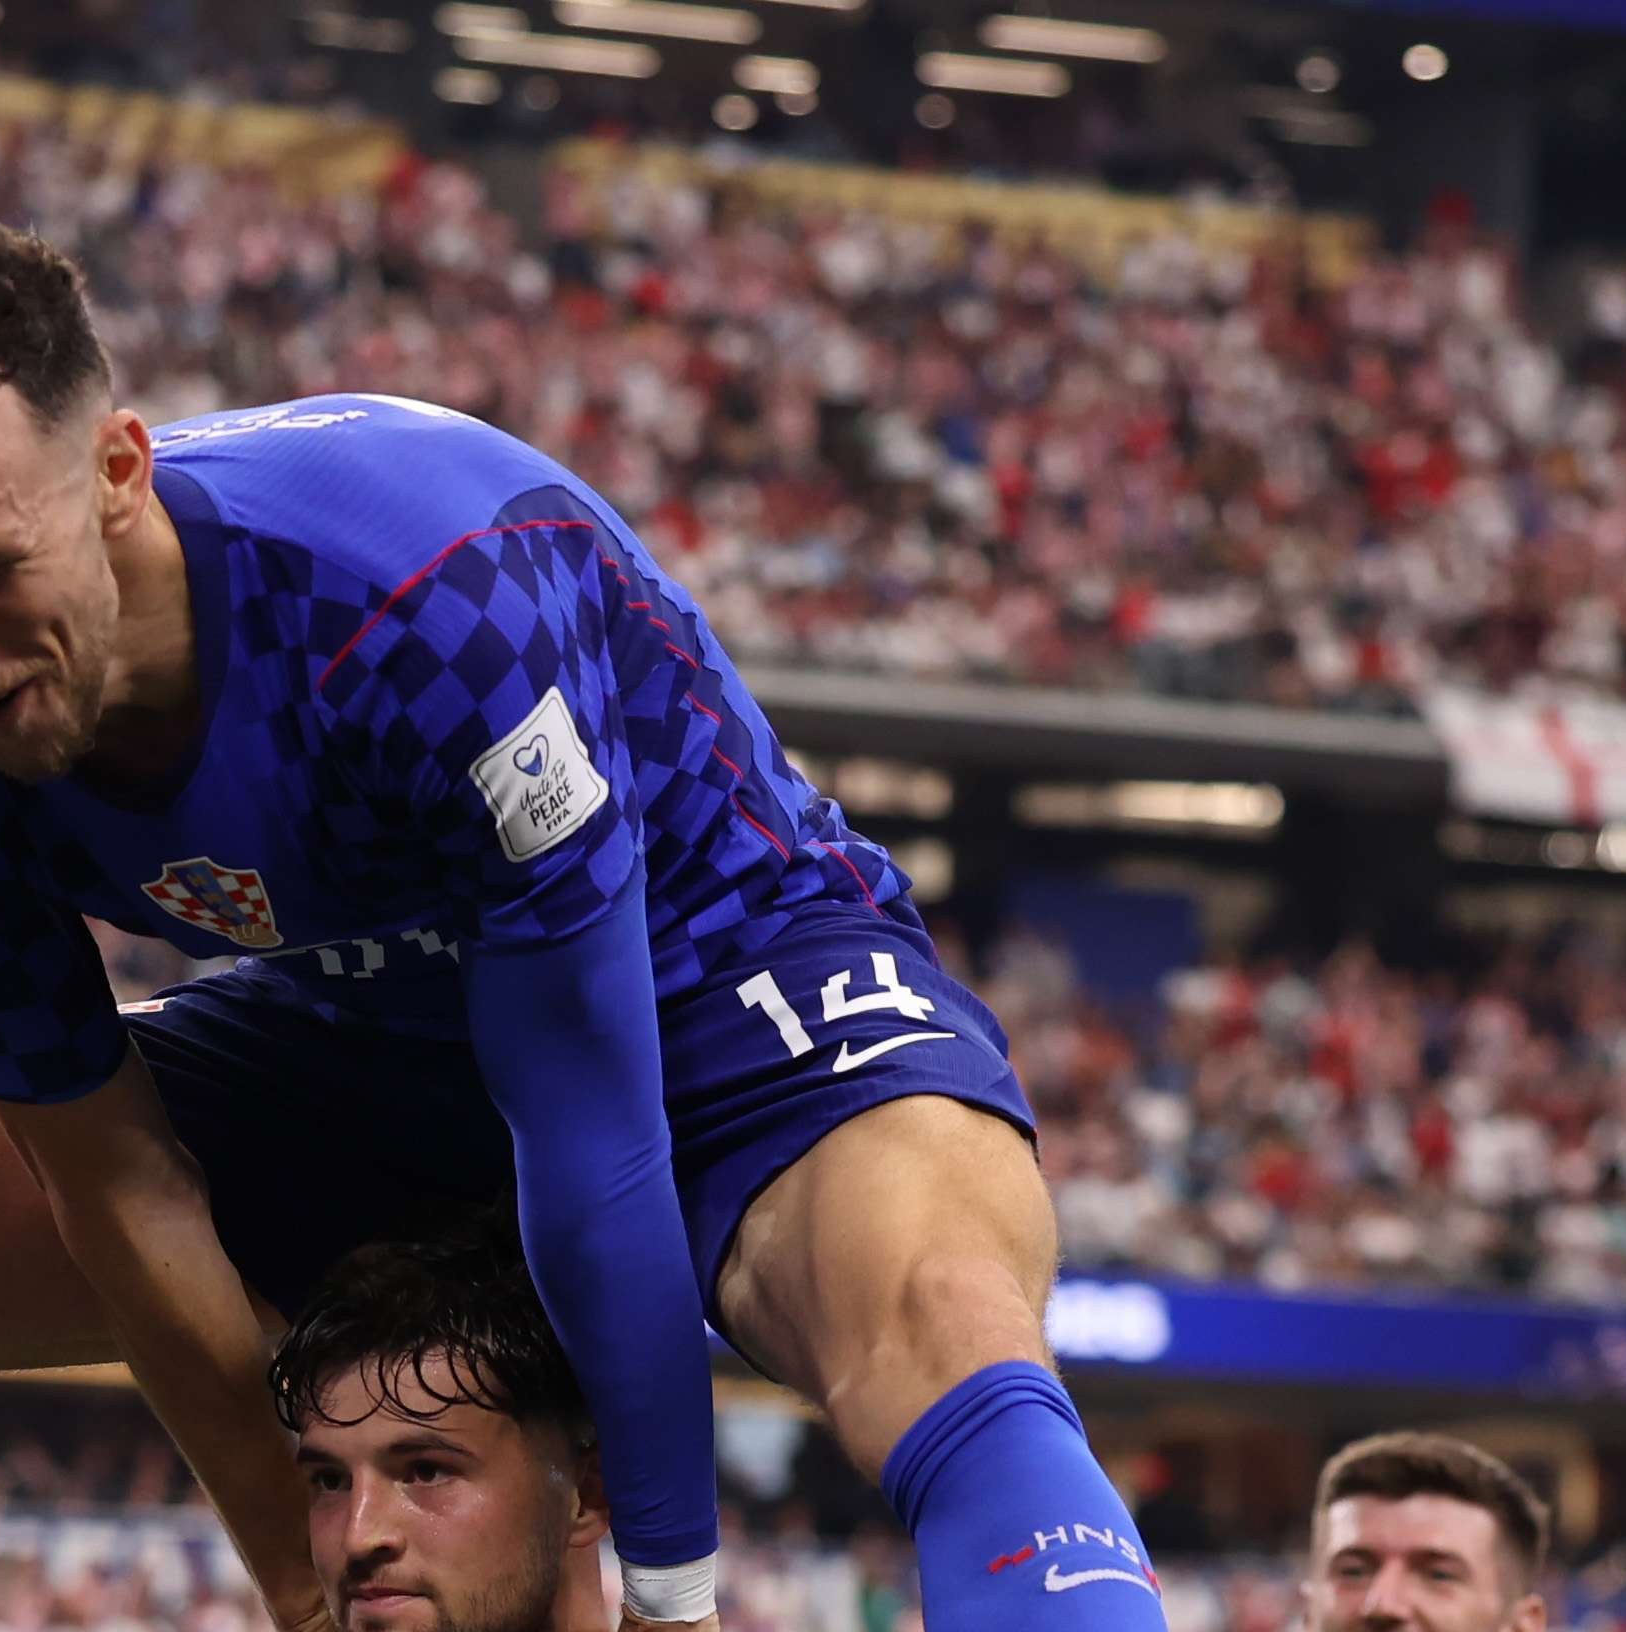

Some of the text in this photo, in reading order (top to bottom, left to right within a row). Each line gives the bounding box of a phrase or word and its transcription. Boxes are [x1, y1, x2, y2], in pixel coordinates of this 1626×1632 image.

[520, 779, 551, 811] Unite
[530, 779, 574, 827] PEACE
[546, 808, 572, 832] FIFA
[736, 952, 935, 1058] 14
[1034, 1523, 1141, 1565] HNS
